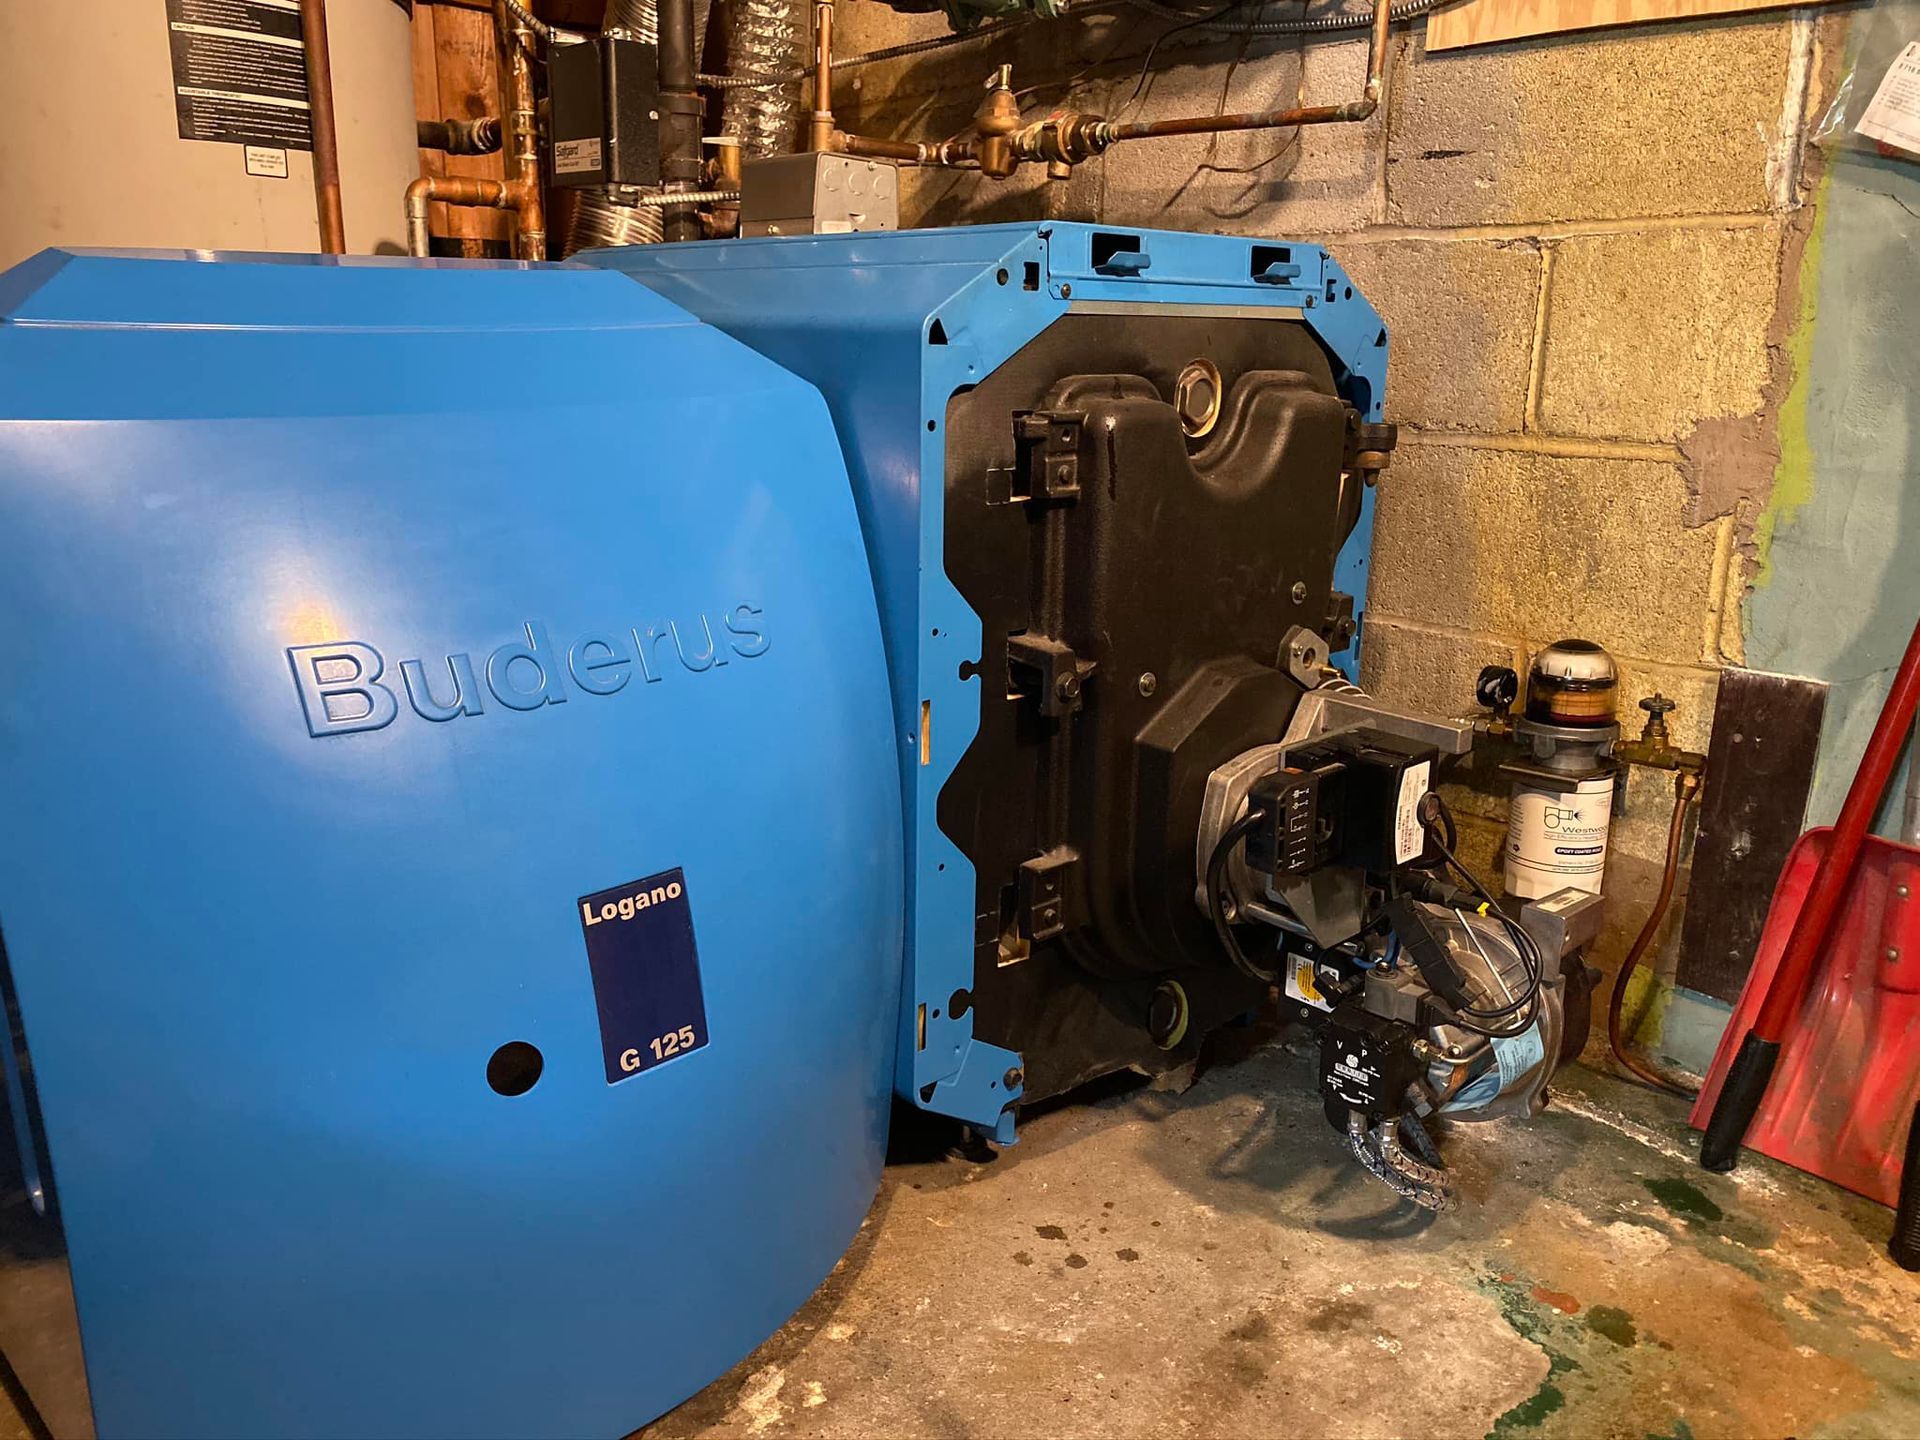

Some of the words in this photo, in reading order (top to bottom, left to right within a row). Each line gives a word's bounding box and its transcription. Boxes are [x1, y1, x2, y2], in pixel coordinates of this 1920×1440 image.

[286, 602, 773, 737] Buderus
[582, 881, 682, 927] Logano
[620, 1048, 640, 1072] G
[649, 1024, 696, 1060] 125
[1336, 1040, 1343, 1049] V
[1361, 1049, 1368, 1057] P
